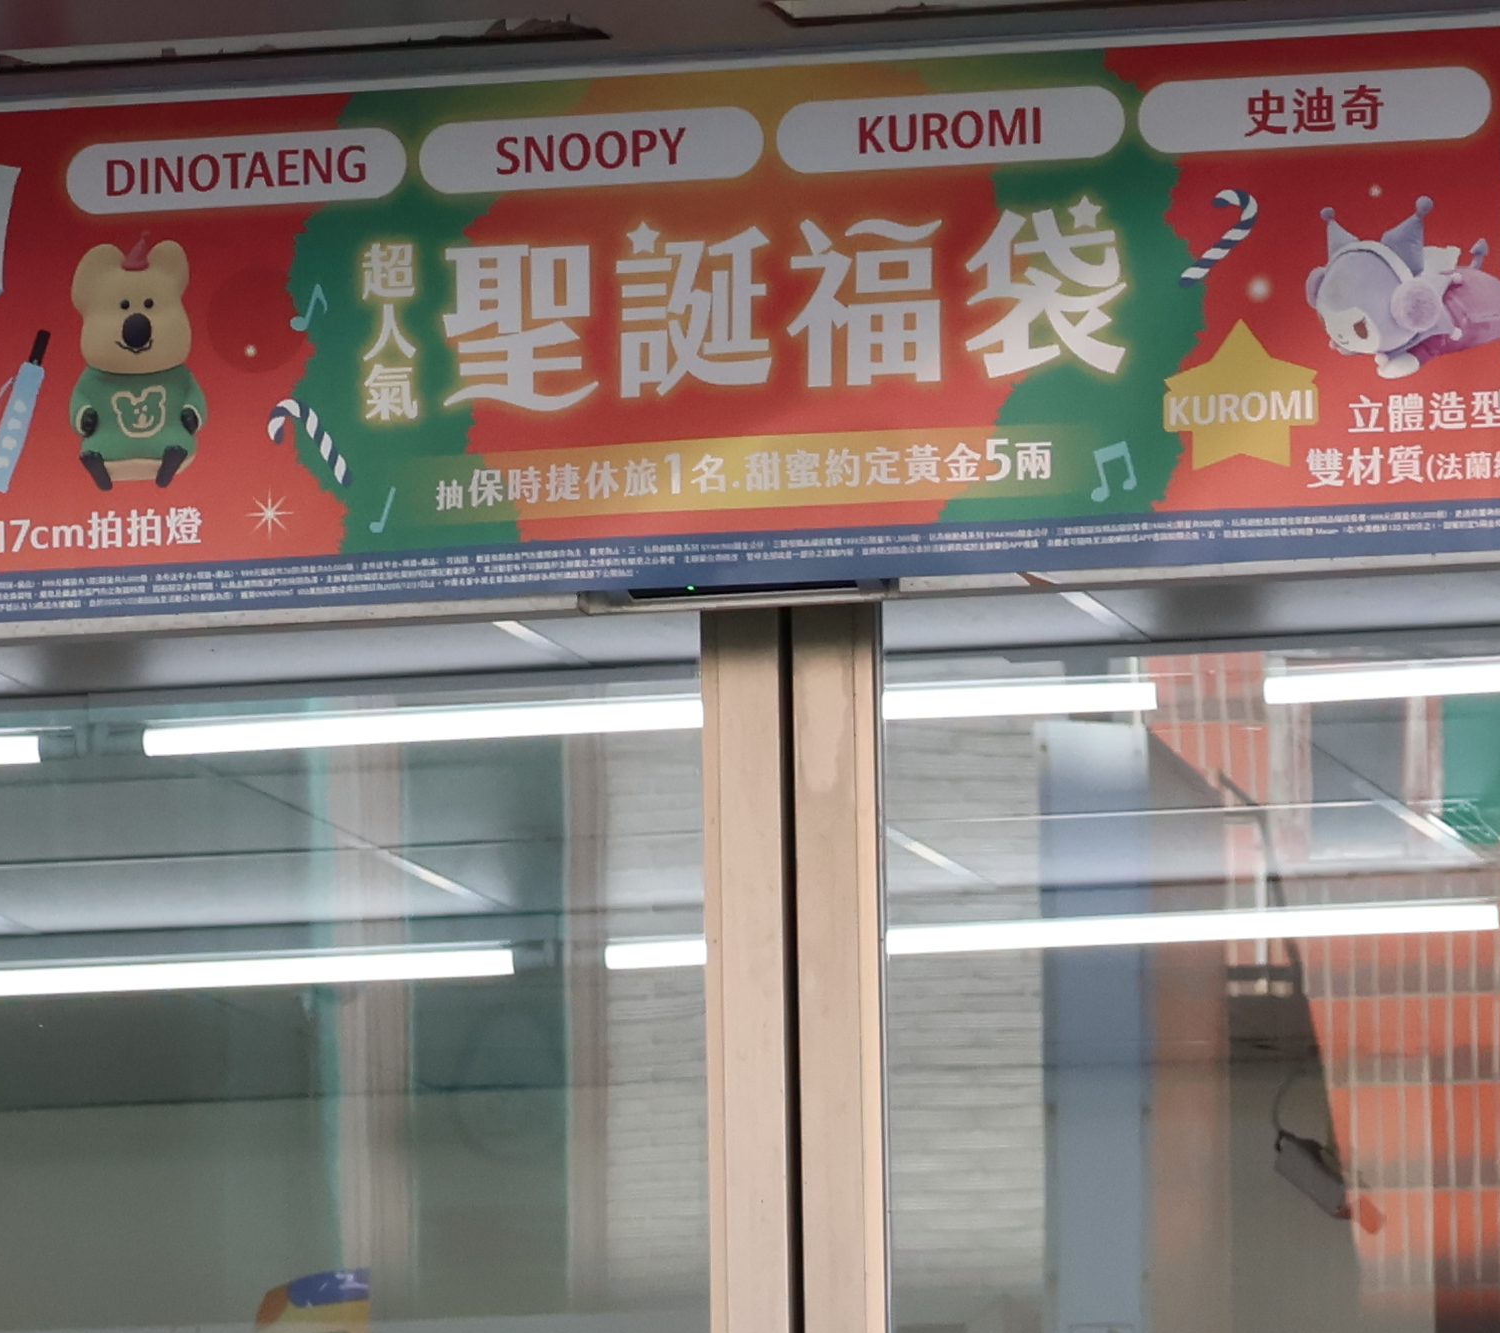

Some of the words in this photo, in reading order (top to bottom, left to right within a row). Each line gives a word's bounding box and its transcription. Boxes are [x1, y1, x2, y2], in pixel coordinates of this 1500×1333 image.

[855, 109, 1045, 156] KUROMI
[1242, 86, 1386, 136] 史迪奇
[104, 147, 370, 199] DINOTAENG
[495, 128, 687, 176] SNOOPY
[442, 202, 1130, 412] 聖誕福袋
[360, 242, 420, 424] 超人氣
[1166, 389, 1316, 426] KUROMI
